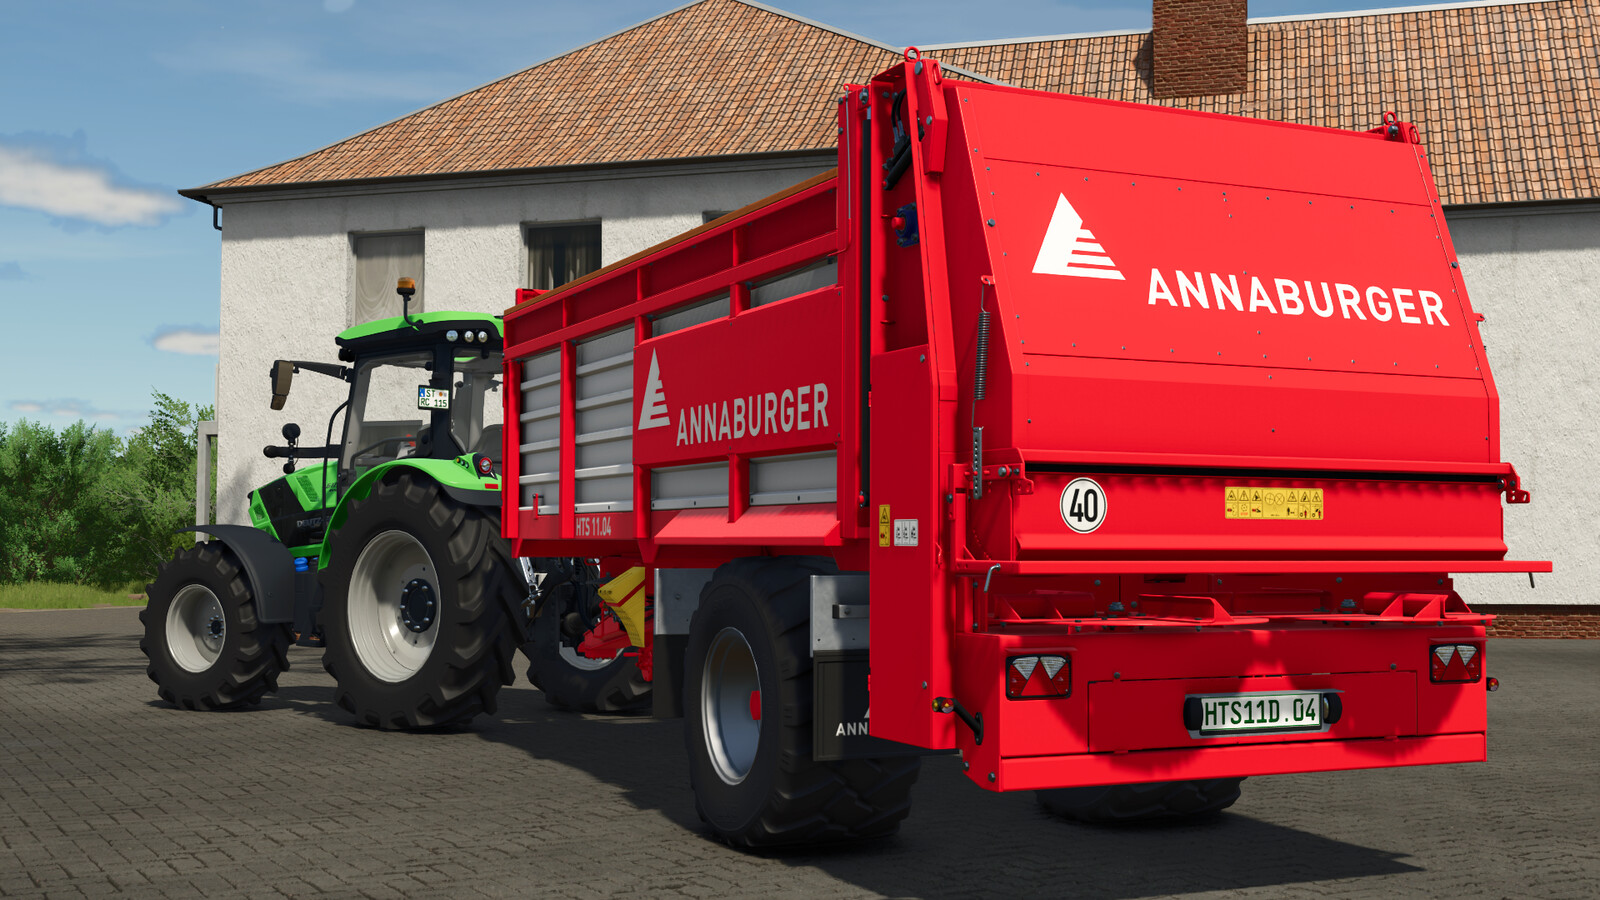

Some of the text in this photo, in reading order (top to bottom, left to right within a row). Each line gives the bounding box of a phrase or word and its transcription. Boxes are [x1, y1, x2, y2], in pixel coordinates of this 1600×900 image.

[1147, 267, 1451, 327] ANNABURGER
[420, 397, 448, 408] RC 115
[425, 389, 435, 398] ST
[676, 382, 829, 447] ANNABURGER
[1069, 488, 1098, 523] 40
[575, 515, 612, 537] HTS 11.04
